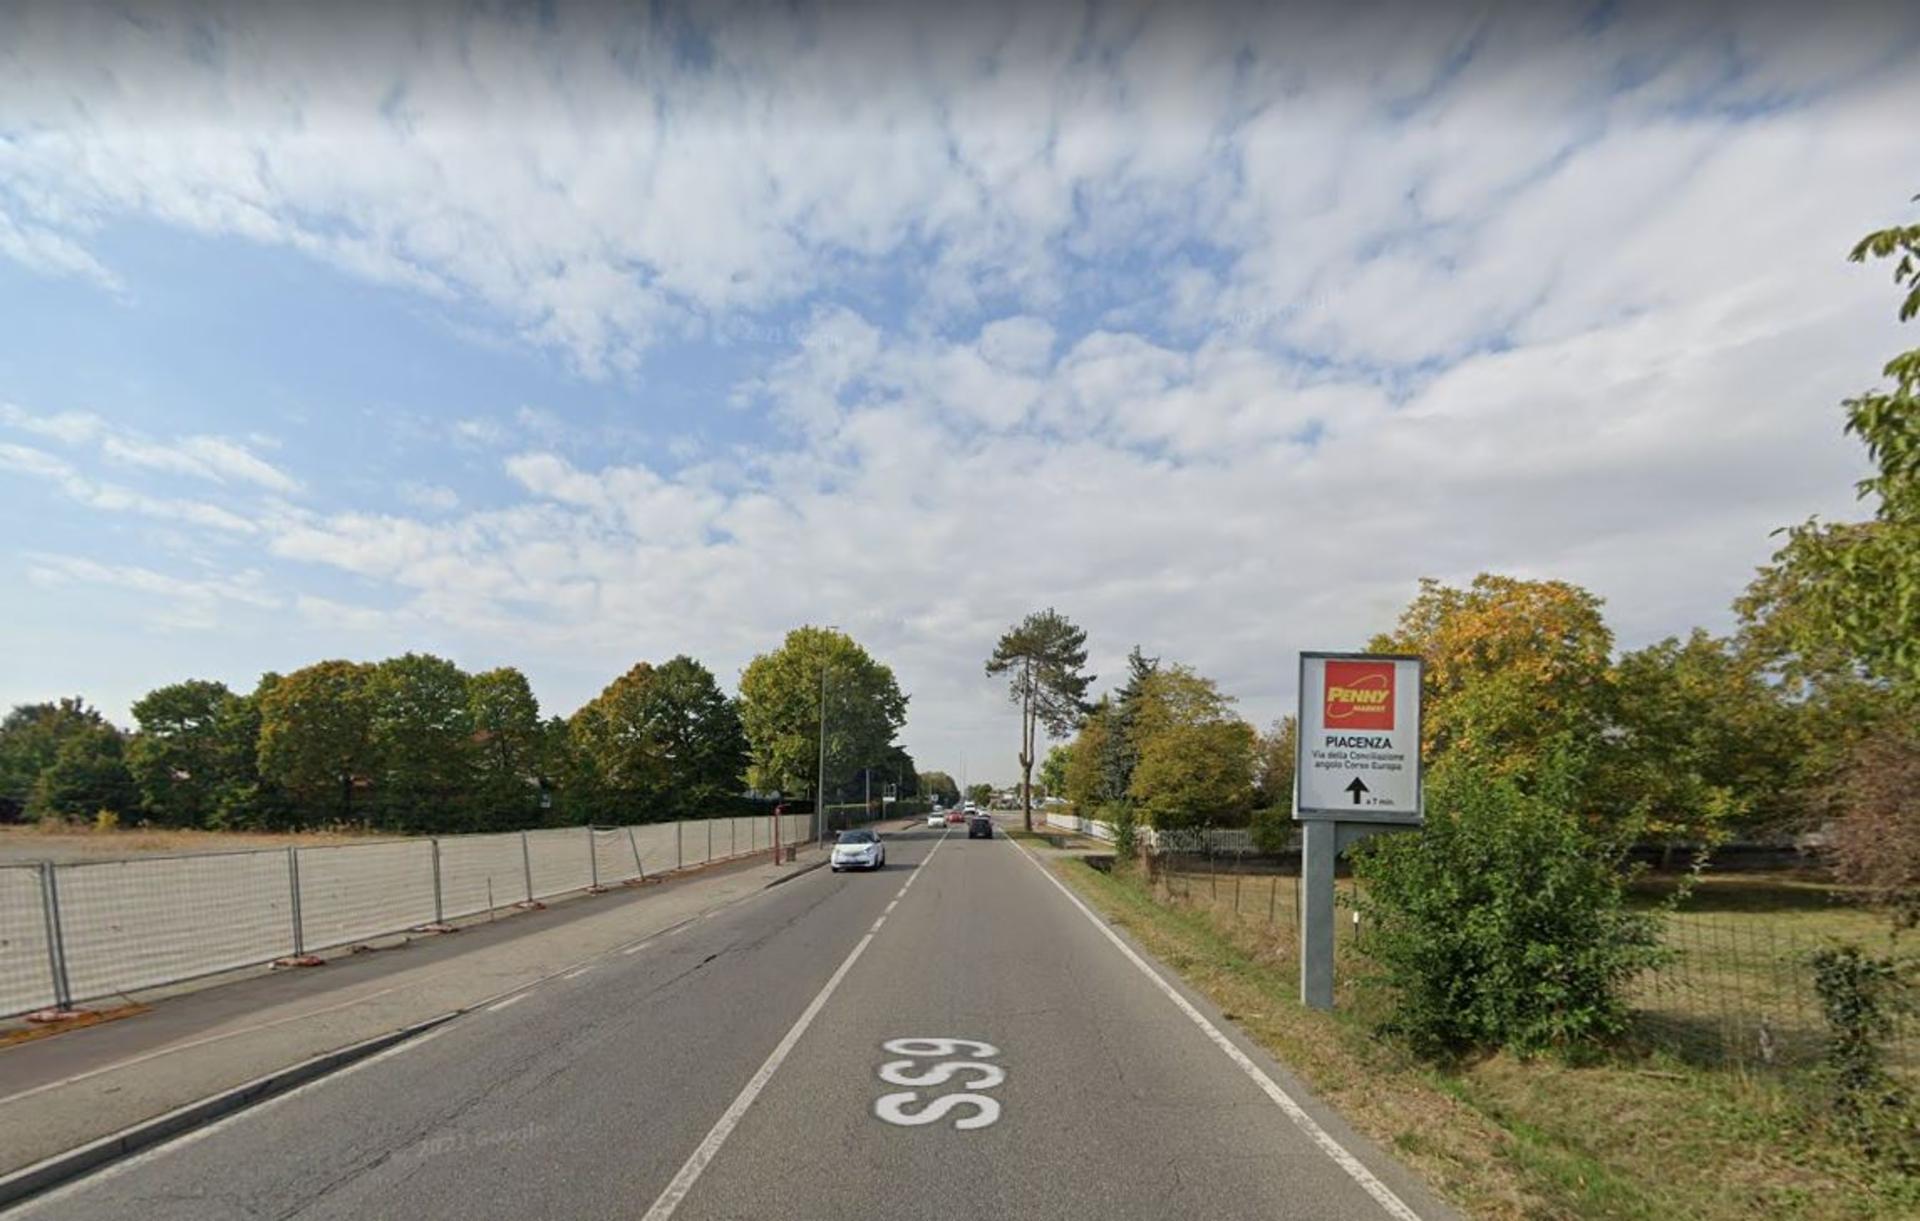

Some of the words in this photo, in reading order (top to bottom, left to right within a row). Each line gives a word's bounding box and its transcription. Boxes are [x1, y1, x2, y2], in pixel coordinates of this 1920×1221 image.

[1328, 687, 1390, 703] PENNY
[1326, 736, 1393, 749] PIACENZA
[1313, 750, 1325, 759] Via
[1327, 751, 1347, 760] della
[1349, 751, 1404, 761] Conciliazione
[1315, 761, 1342, 770] angolo
[1344, 760, 1369, 769] Corso
[1371, 761, 1402, 771] Europa
[876, 1038, 1006, 1129] SS9
